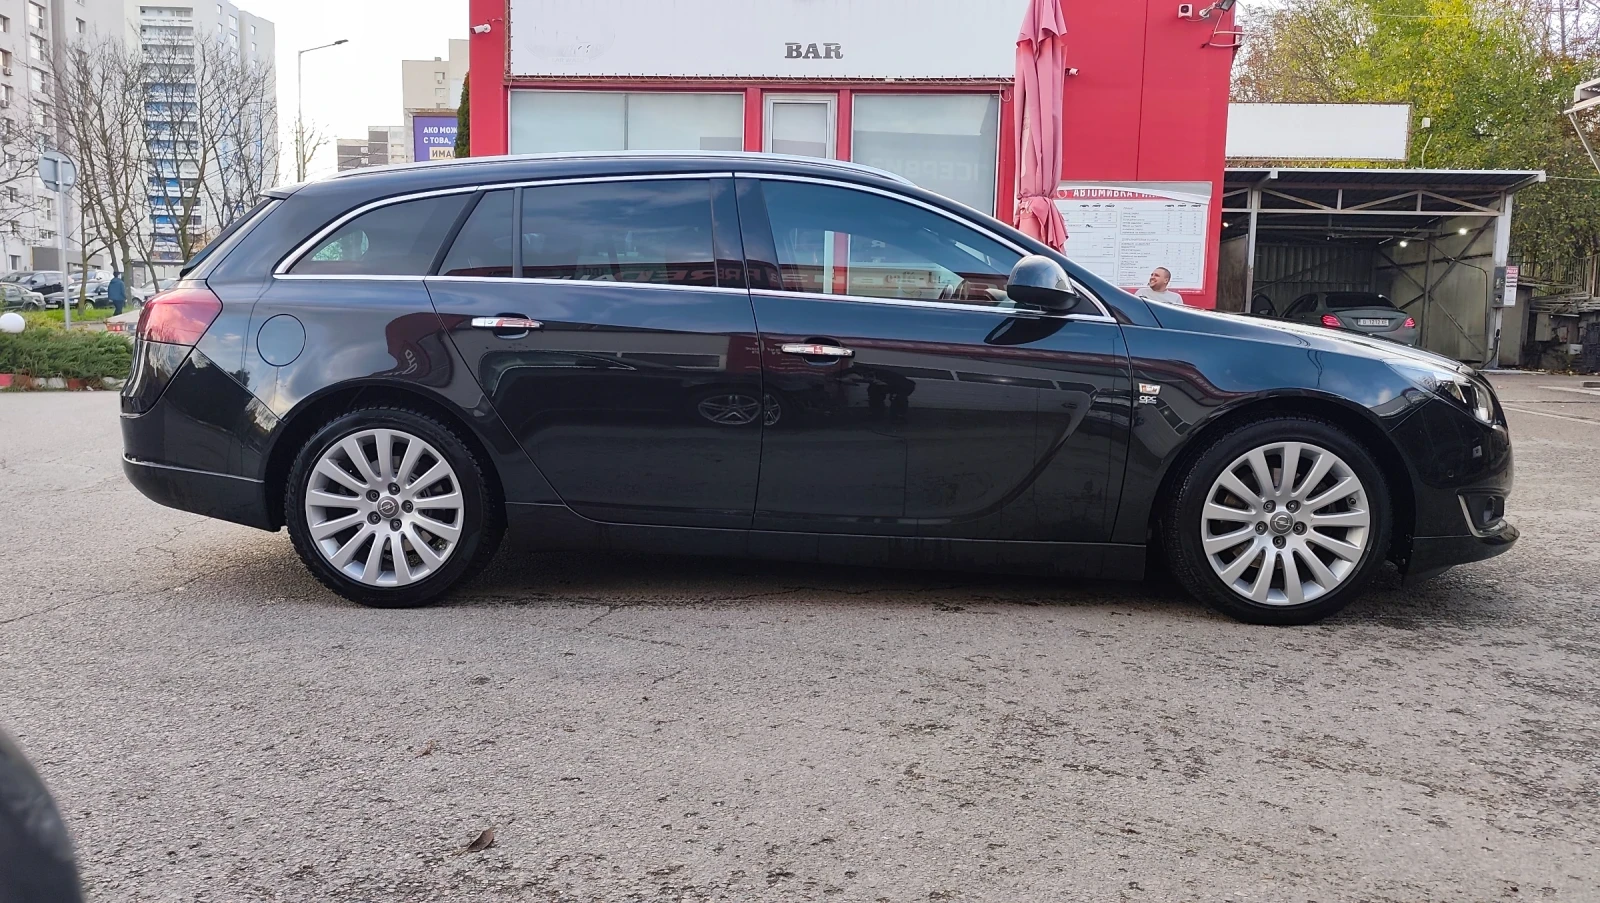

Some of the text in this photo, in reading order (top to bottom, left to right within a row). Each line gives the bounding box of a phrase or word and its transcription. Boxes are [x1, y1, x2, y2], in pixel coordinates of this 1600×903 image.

[784, 42, 844, 60] BAR
[423, 126, 439, 134] АКО
[430, 136, 452, 145] ТОВА,
